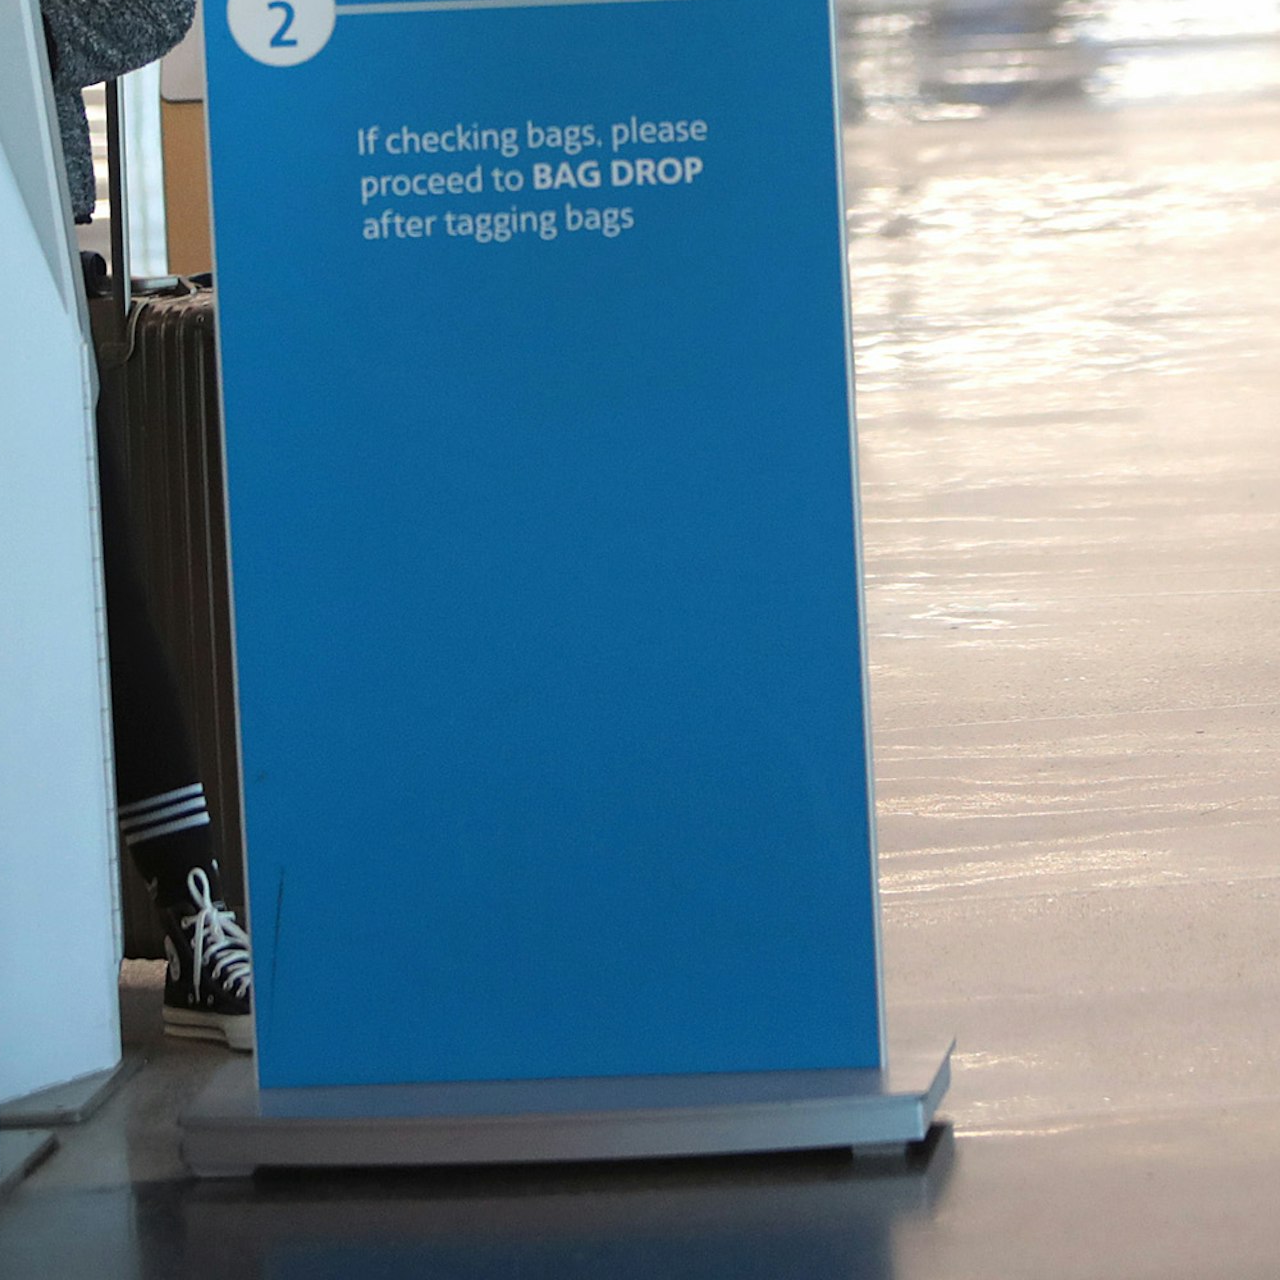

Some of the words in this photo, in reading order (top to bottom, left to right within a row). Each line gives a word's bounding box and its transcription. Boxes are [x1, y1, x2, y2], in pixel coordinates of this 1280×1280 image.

[266, 0, 299, 48] 2
[357, 125, 379, 156] If
[384, 123, 520, 158] checking
[526, 120, 603, 156] bags,
[611, 115, 708, 153] please
[360, 164, 483, 206] proceed
[490, 167, 525, 194] to
[532, 159, 602, 190] BAG
[610, 156, 704, 187] DROP
[362, 208, 437, 240] after
[444, 206, 558, 244] tagging
[565, 202, 635, 238] bags
